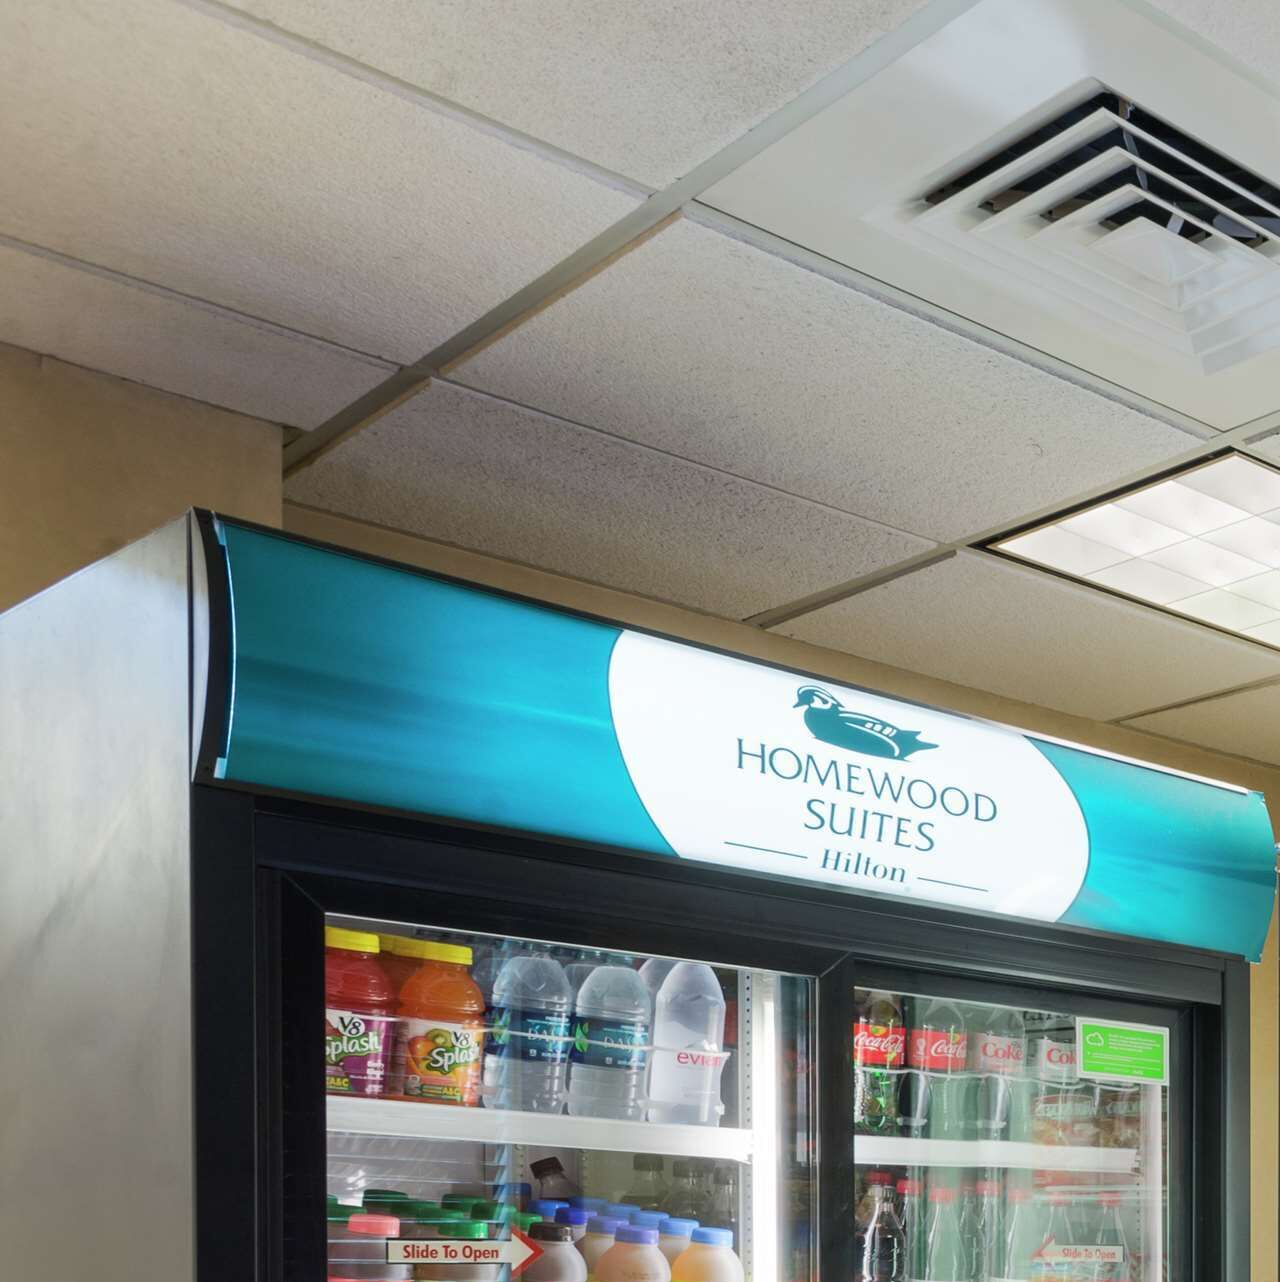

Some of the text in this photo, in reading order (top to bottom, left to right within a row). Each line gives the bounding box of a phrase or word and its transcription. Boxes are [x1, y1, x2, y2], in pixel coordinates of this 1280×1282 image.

[736, 738, 999, 824] HOMEWOOD
[804, 798, 936, 853] SUITES
[820, 846, 908, 885] Hilton
[338, 1016, 362, 1037] V8
[453, 1030, 471, 1045] V8
[981, 1041, 1023, 1060] Coke
[1047, 1047, 1076, 1065] Cok
[402, 1244, 500, 1264] Slide To Open
